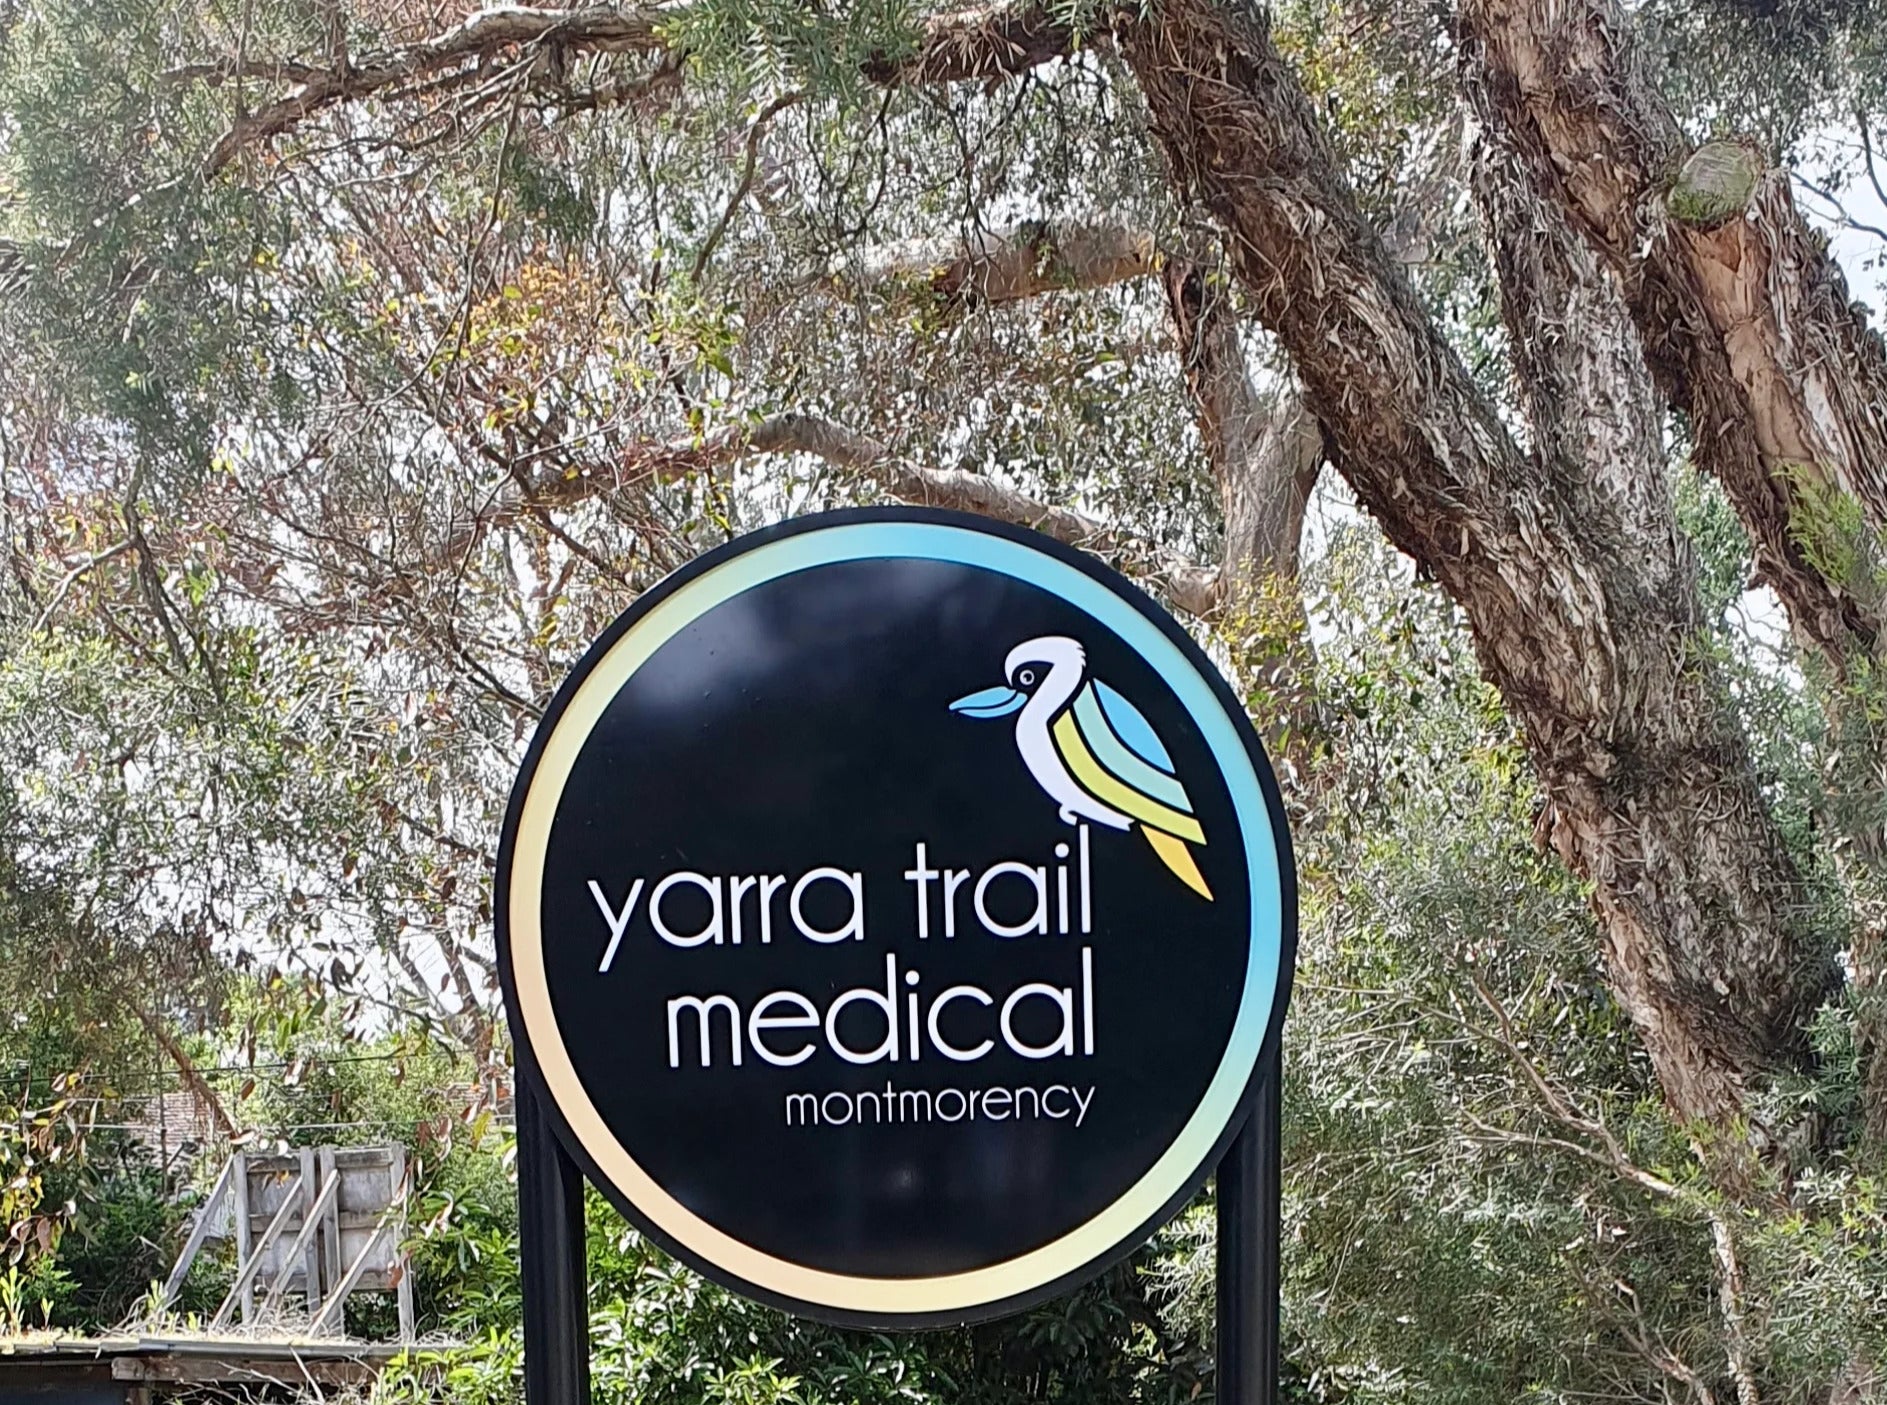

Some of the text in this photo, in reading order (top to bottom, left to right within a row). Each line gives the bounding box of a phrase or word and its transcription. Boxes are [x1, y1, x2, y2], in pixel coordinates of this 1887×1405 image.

[587, 823, 1092, 972] yarra trail
[666, 945, 1095, 1069] medical
[785, 1080, 1096, 1128] montmorency
